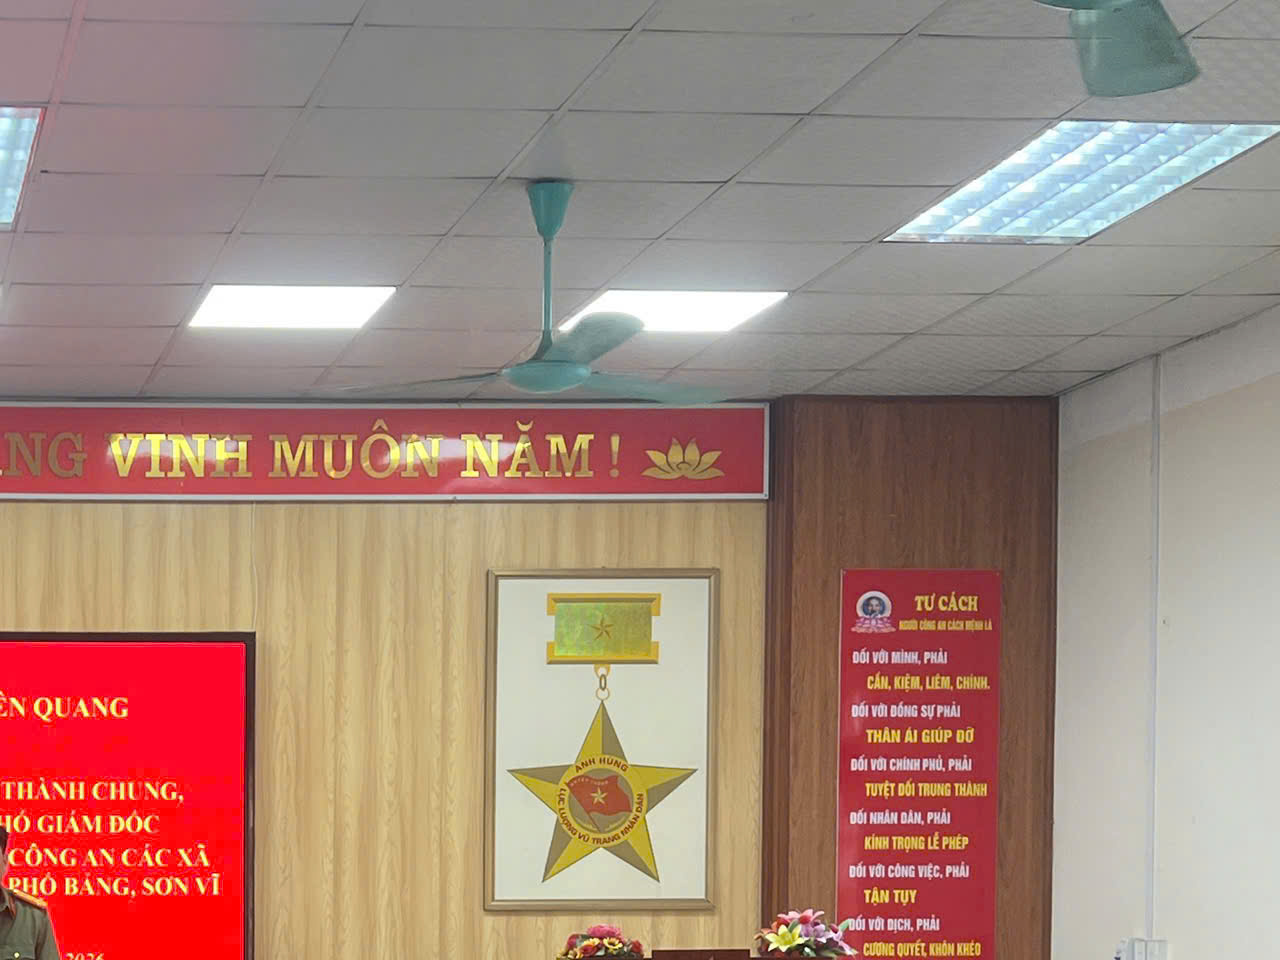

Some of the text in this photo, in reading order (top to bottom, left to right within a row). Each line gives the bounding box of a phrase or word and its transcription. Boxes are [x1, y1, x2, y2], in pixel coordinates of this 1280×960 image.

[107, 432, 254, 480] VINH
[268, 418, 441, 480] MUÔN
[459, 420, 595, 480] NĂM
[915, 591, 978, 612] TƯ CÁCH
[852, 647, 869, 664] ĐỐI
[872, 648, 888, 664] VỚI
[924, 648, 947, 664] PHẢI
[34, 697, 128, 722] QUANG
[851, 701, 868, 718] ĐỐI
[871, 702, 887, 718] VỚI
[920, 703, 936, 720] SỰ
[937, 701, 961, 718] PHẢI
[866, 727, 901, 743] THÂN
[905, 726, 918, 743] ÁI
[921, 727, 953, 743] GIÚP
[575, 758, 596, 773] ANH
[850, 754, 868, 772] ĐỐI
[870, 755, 887, 772] VỚI
[889, 755, 920, 772] CHÍNH
[948, 755, 972, 772] PHẢI
[2, 777, 84, 800] THÀNH
[92, 782, 184, 805] CHUNG,
[865, 778, 987, 800] TUYỆT ĐỐI TRUNG THÀNH
[37, 810, 101, 833] GIÁM
[850, 808, 867, 825] ĐỐI
[869, 809, 898, 825] NHÂN
[927, 808, 950, 825] PHẢI
[592, 832, 621, 845] TRANG
[864, 834, 889, 850] KÍNH
[892, 836, 925, 853] TRỌNG
[942, 833, 969, 850] PHÉP
[7, 842, 77, 866] CÔNG
[82, 848, 114, 866] AN
[122, 844, 170, 867] CÁC
[177, 843, 210, 866] XÃ
[849, 861, 866, 878] ĐỐI
[869, 862, 885, 878] VỚI
[888, 863, 915, 878] CÔNG
[946, 861, 969, 878] PHẢI
[141, 875, 188, 896] SƠN
[196, 873, 220, 896] VĨ
[864, 887, 917, 906] TẬN TỤY
[868, 915, 885, 931] VỚI
[916, 914, 940, 931] PHẢI
[929, 940, 955, 956] KHÔN
[956, 940, 981, 956] KHÉO
